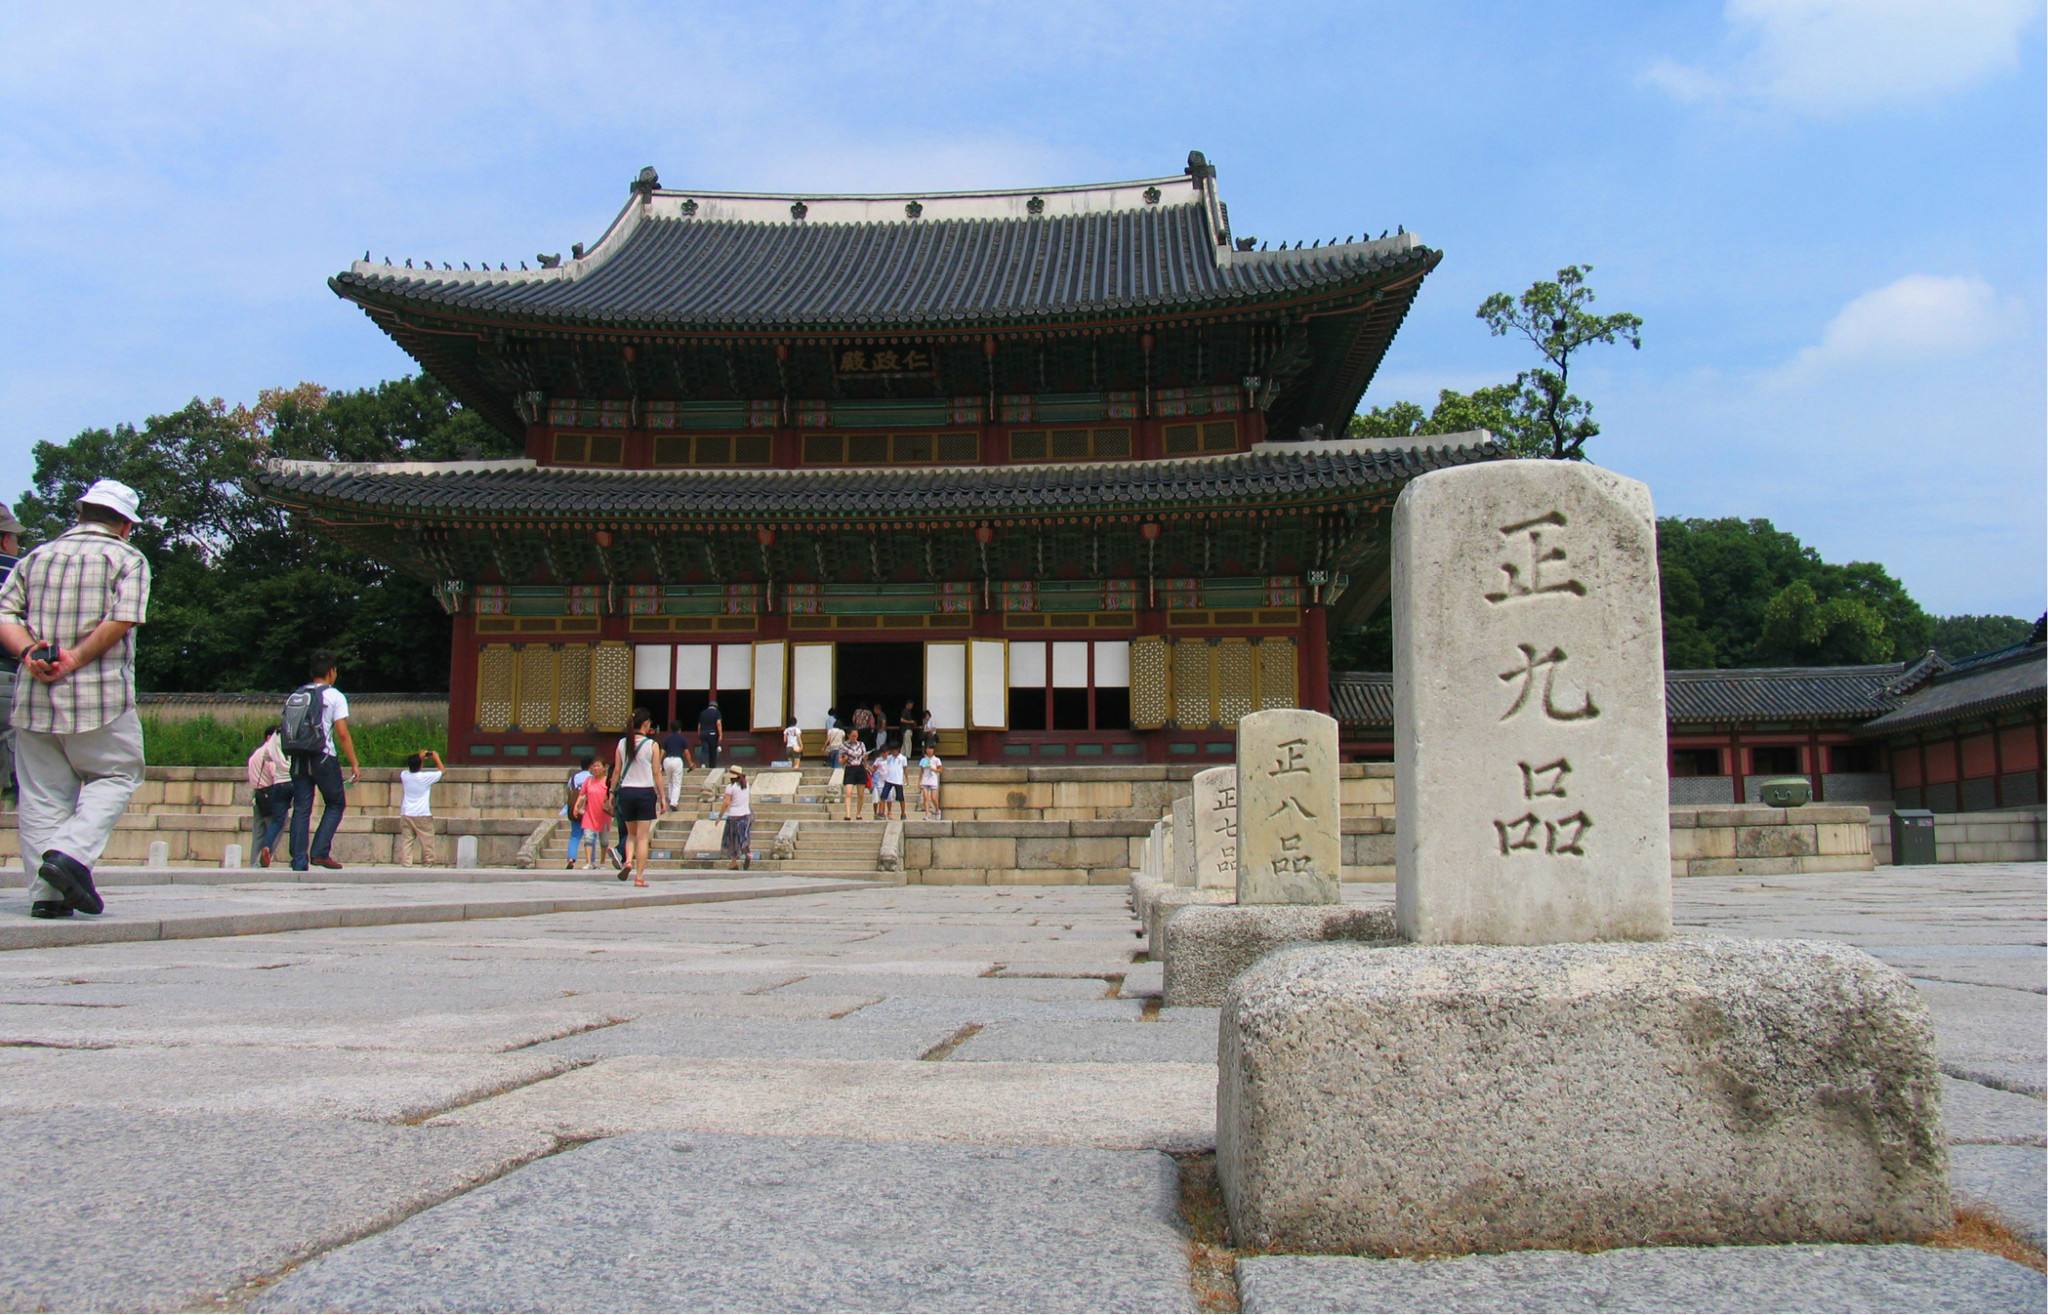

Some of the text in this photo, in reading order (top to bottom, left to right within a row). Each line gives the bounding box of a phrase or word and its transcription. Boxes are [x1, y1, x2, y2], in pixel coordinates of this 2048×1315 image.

[1484, 510, 1600, 857] 正九品
[1212, 786, 1237, 874] 正七品
[1266, 738, 1317, 876] 正八品
